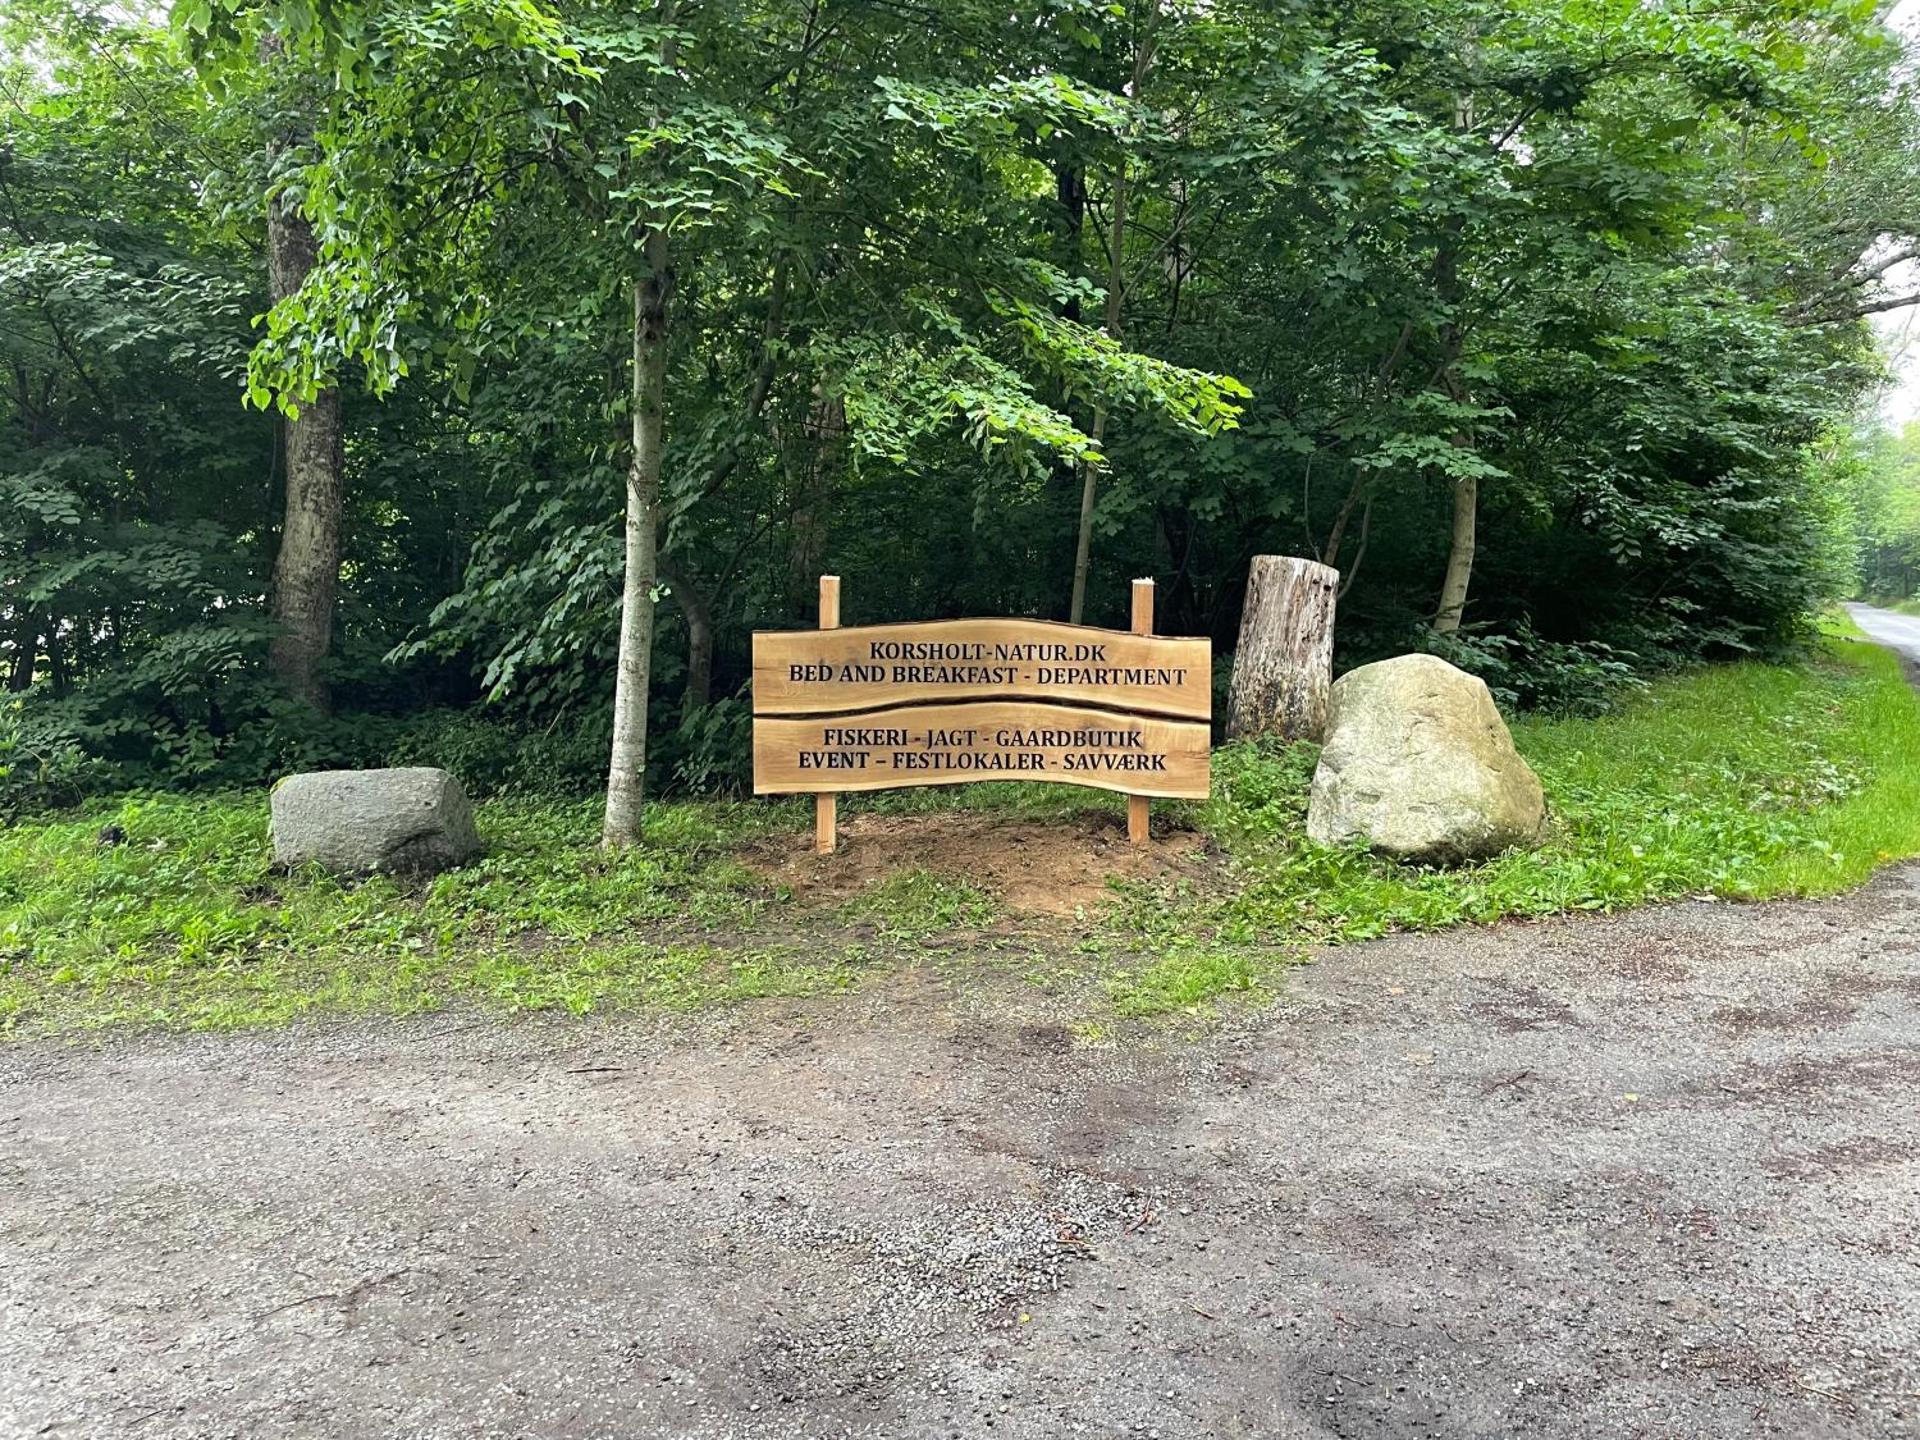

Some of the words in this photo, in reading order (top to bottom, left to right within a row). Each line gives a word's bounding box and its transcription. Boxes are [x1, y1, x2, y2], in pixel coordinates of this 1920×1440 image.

[870, 642, 1106, 662] KORSHOLT-NATUR.DK
[789, 664, 833, 682] BED
[838, 664, 886, 683] AND
[891, 665, 1019, 684] BREAKFAST
[1037, 667, 1187, 685] DEPARTMENT
[823, 728, 908, 746] FISKERI
[926, 729, 978, 749] JAGT
[996, 729, 1143, 748] GAARDBUTIK
[798, 751, 871, 769] EVENT
[892, 751, 1045, 770] FESTLOKALER
[1063, 753, 1167, 771] SAVVÆRK
